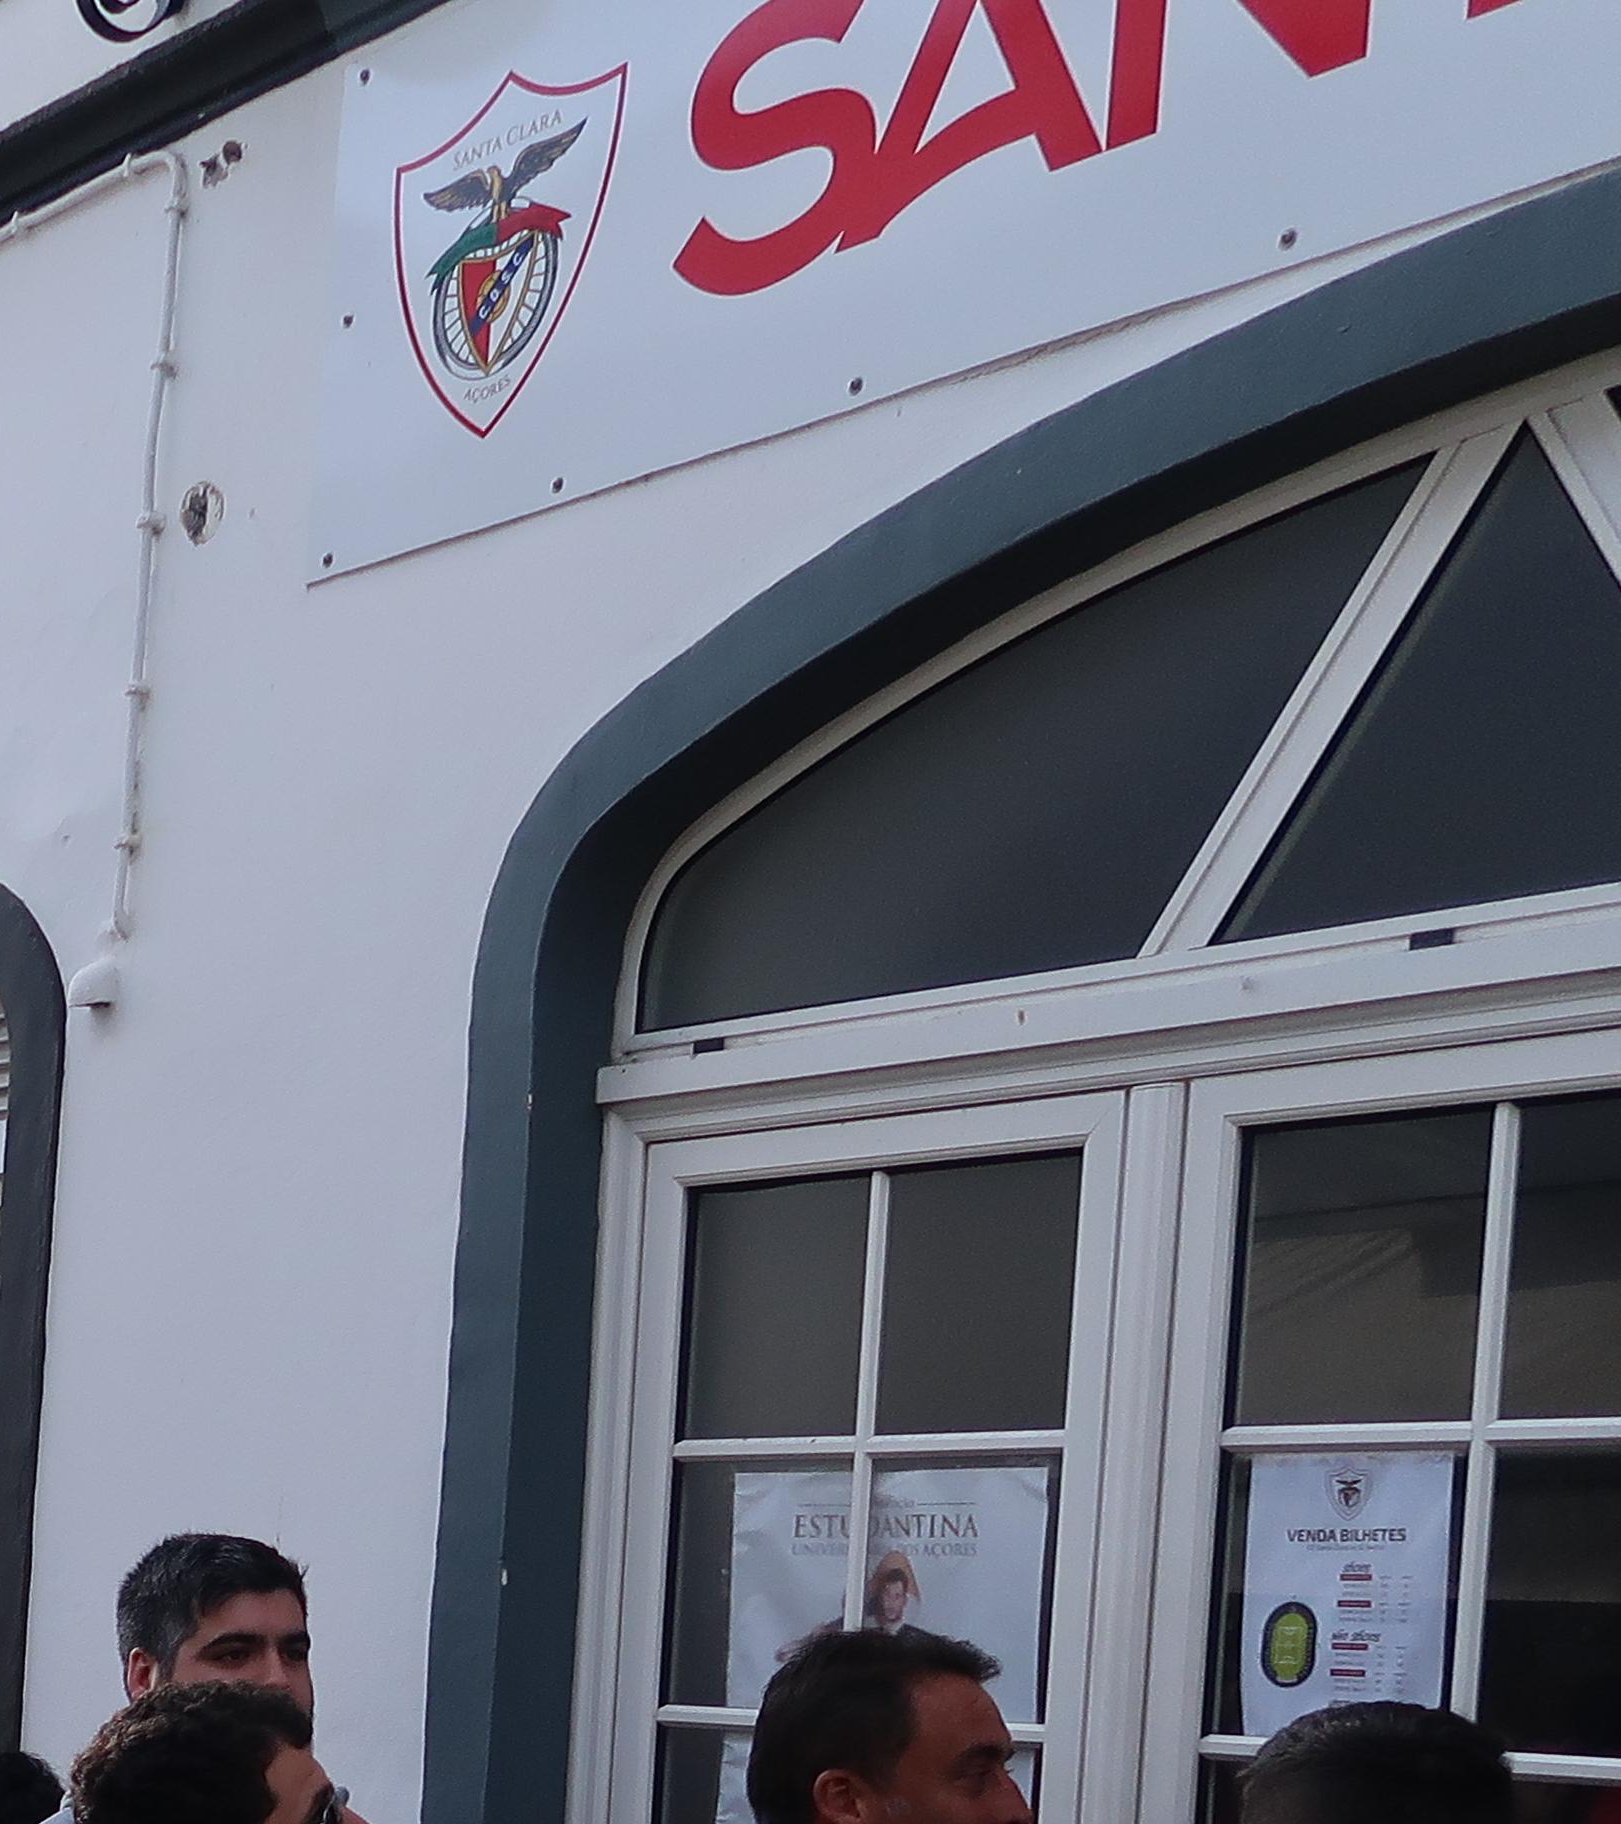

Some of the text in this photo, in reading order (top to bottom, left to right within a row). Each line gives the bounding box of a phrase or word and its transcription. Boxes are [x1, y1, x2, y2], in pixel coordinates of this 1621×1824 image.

[452, 108, 563, 171] SANTA CLARA
[462, 374, 512, 405] AÇORES
[1286, 1527, 1407, 1543] VENDA BILHETES
